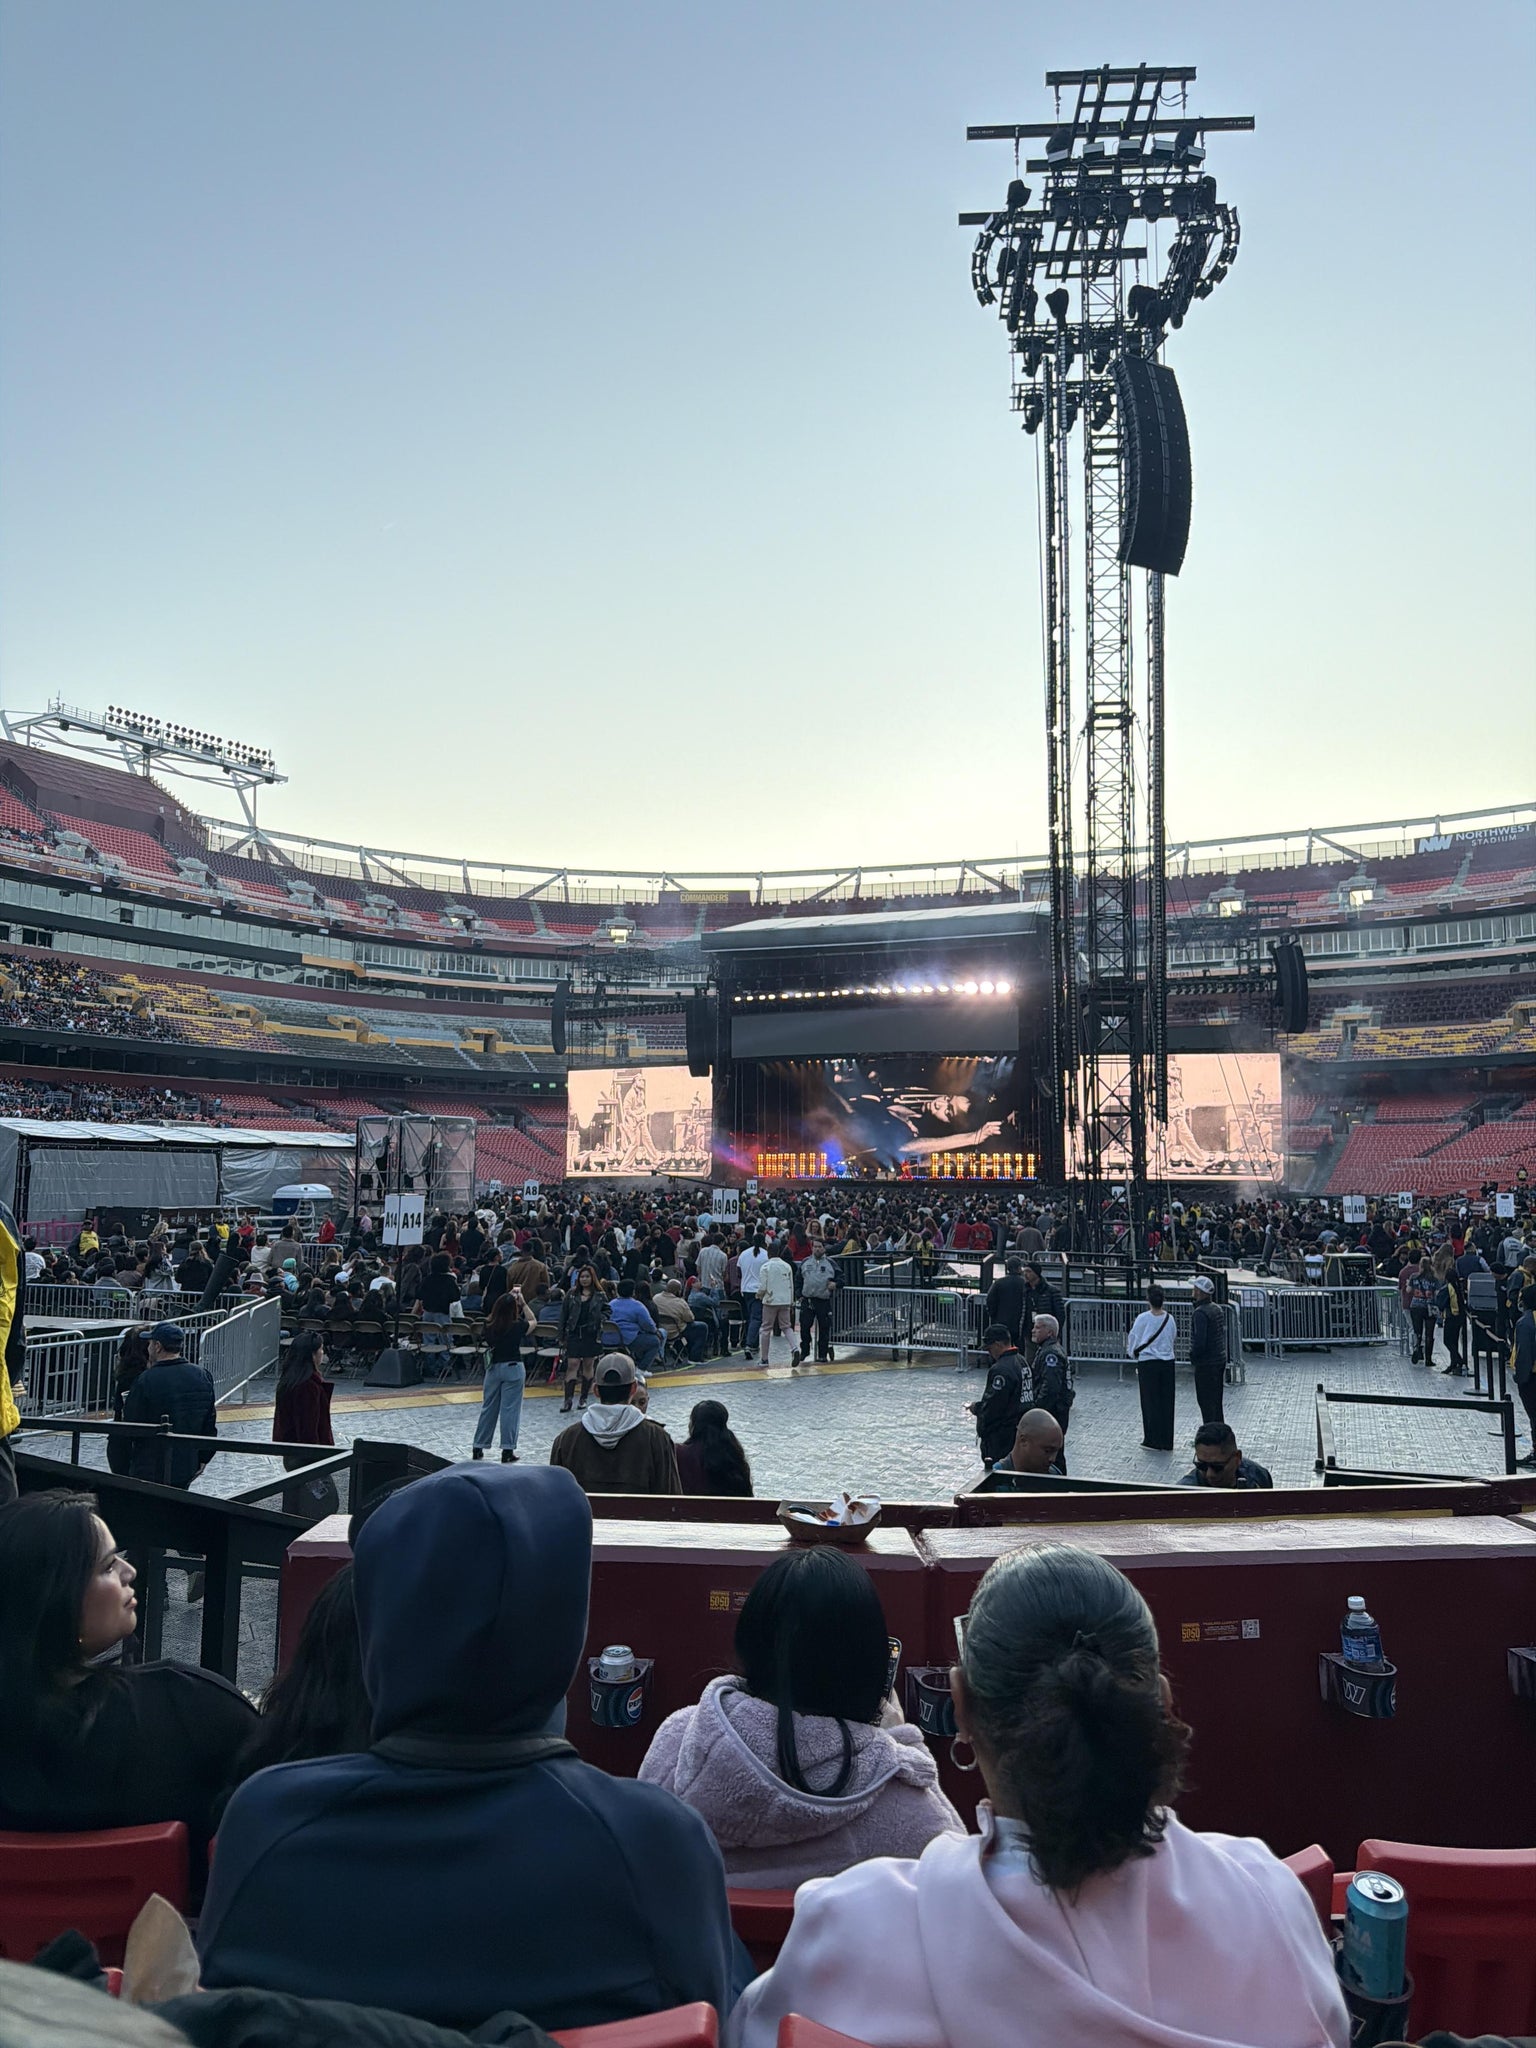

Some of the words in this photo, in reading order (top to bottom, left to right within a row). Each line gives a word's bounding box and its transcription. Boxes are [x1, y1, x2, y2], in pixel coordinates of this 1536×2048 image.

[1455, 823, 1532, 841] NORTHWEST
[1471, 834, 1517, 847] STADIUM
[525, 1186, 538, 1196] A8
[714, 1199, 721, 1215] A9
[725, 1199, 738, 1215] A9
[1400, 1196, 1411, 1205] A5
[1353, 1204, 1366, 1214] A10
[385, 1211, 398, 1229] A14
[401, 1212, 422, 1229] A14
